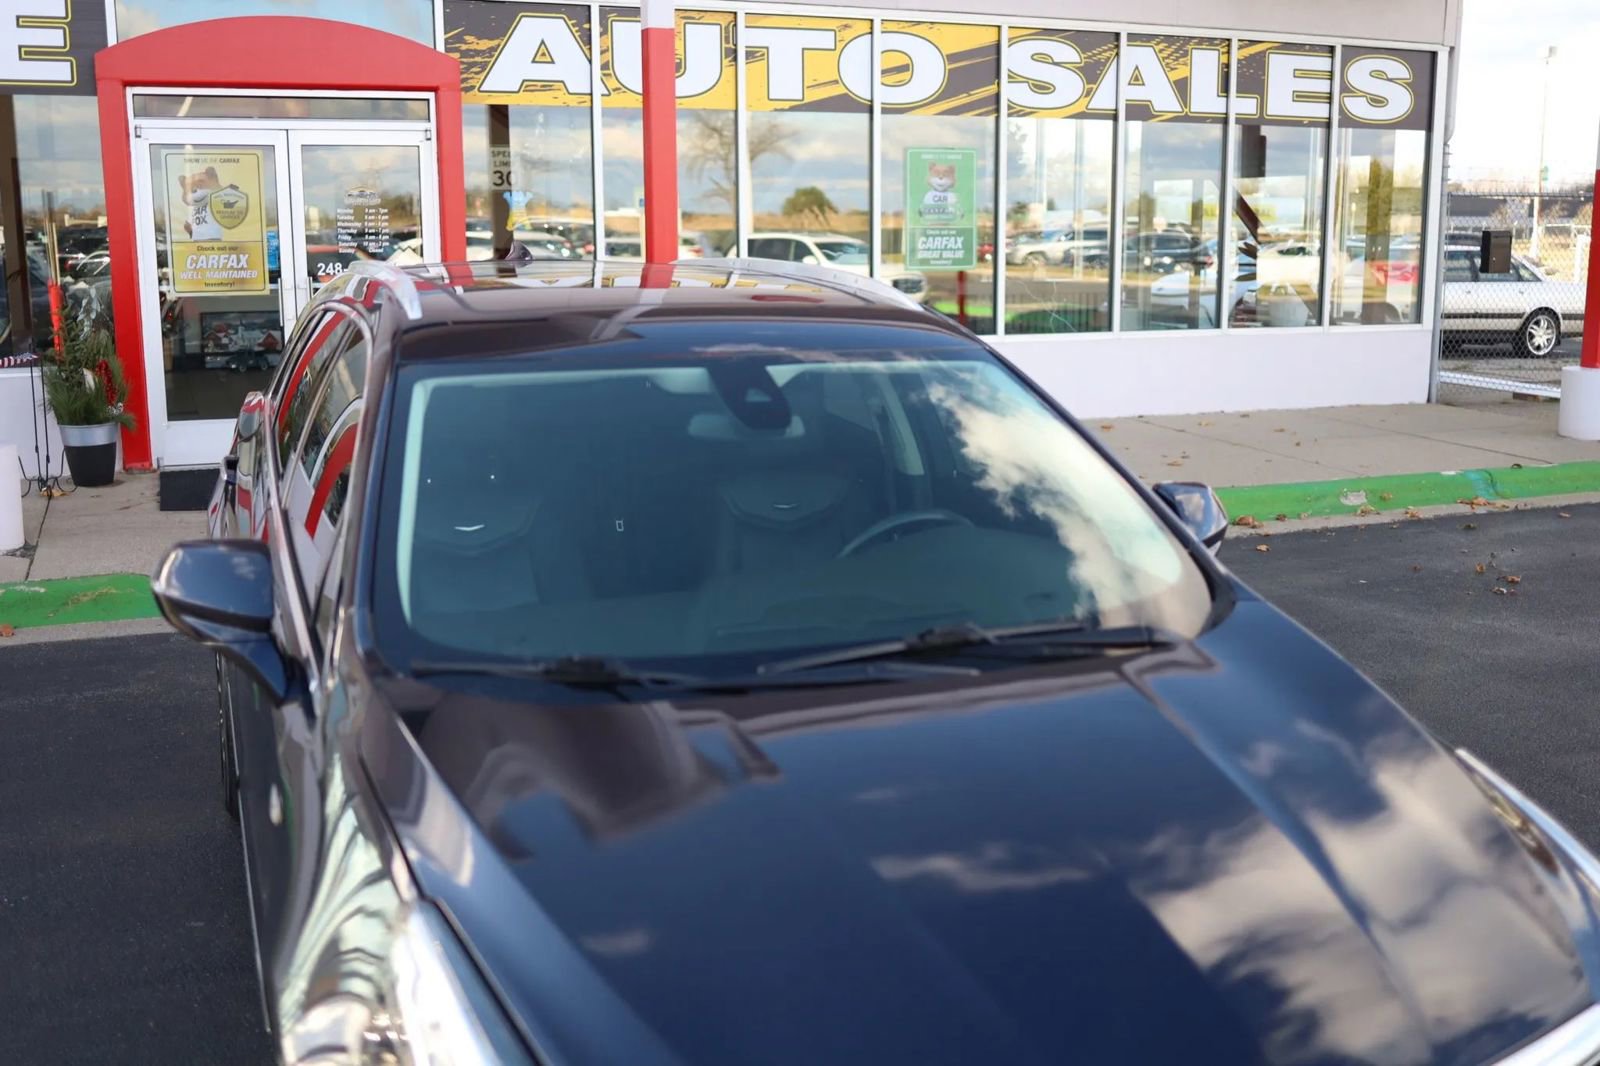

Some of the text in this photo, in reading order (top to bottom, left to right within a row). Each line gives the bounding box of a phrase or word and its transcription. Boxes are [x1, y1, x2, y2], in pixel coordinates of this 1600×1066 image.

[477, 13, 948, 107] AUTO
[1006, 36, 1414, 124] SALES
[918, 236, 965, 250] CARFAX
[186, 254, 249, 270] CARFAX
[181, 269, 258, 280] WELL MAINTAINED
